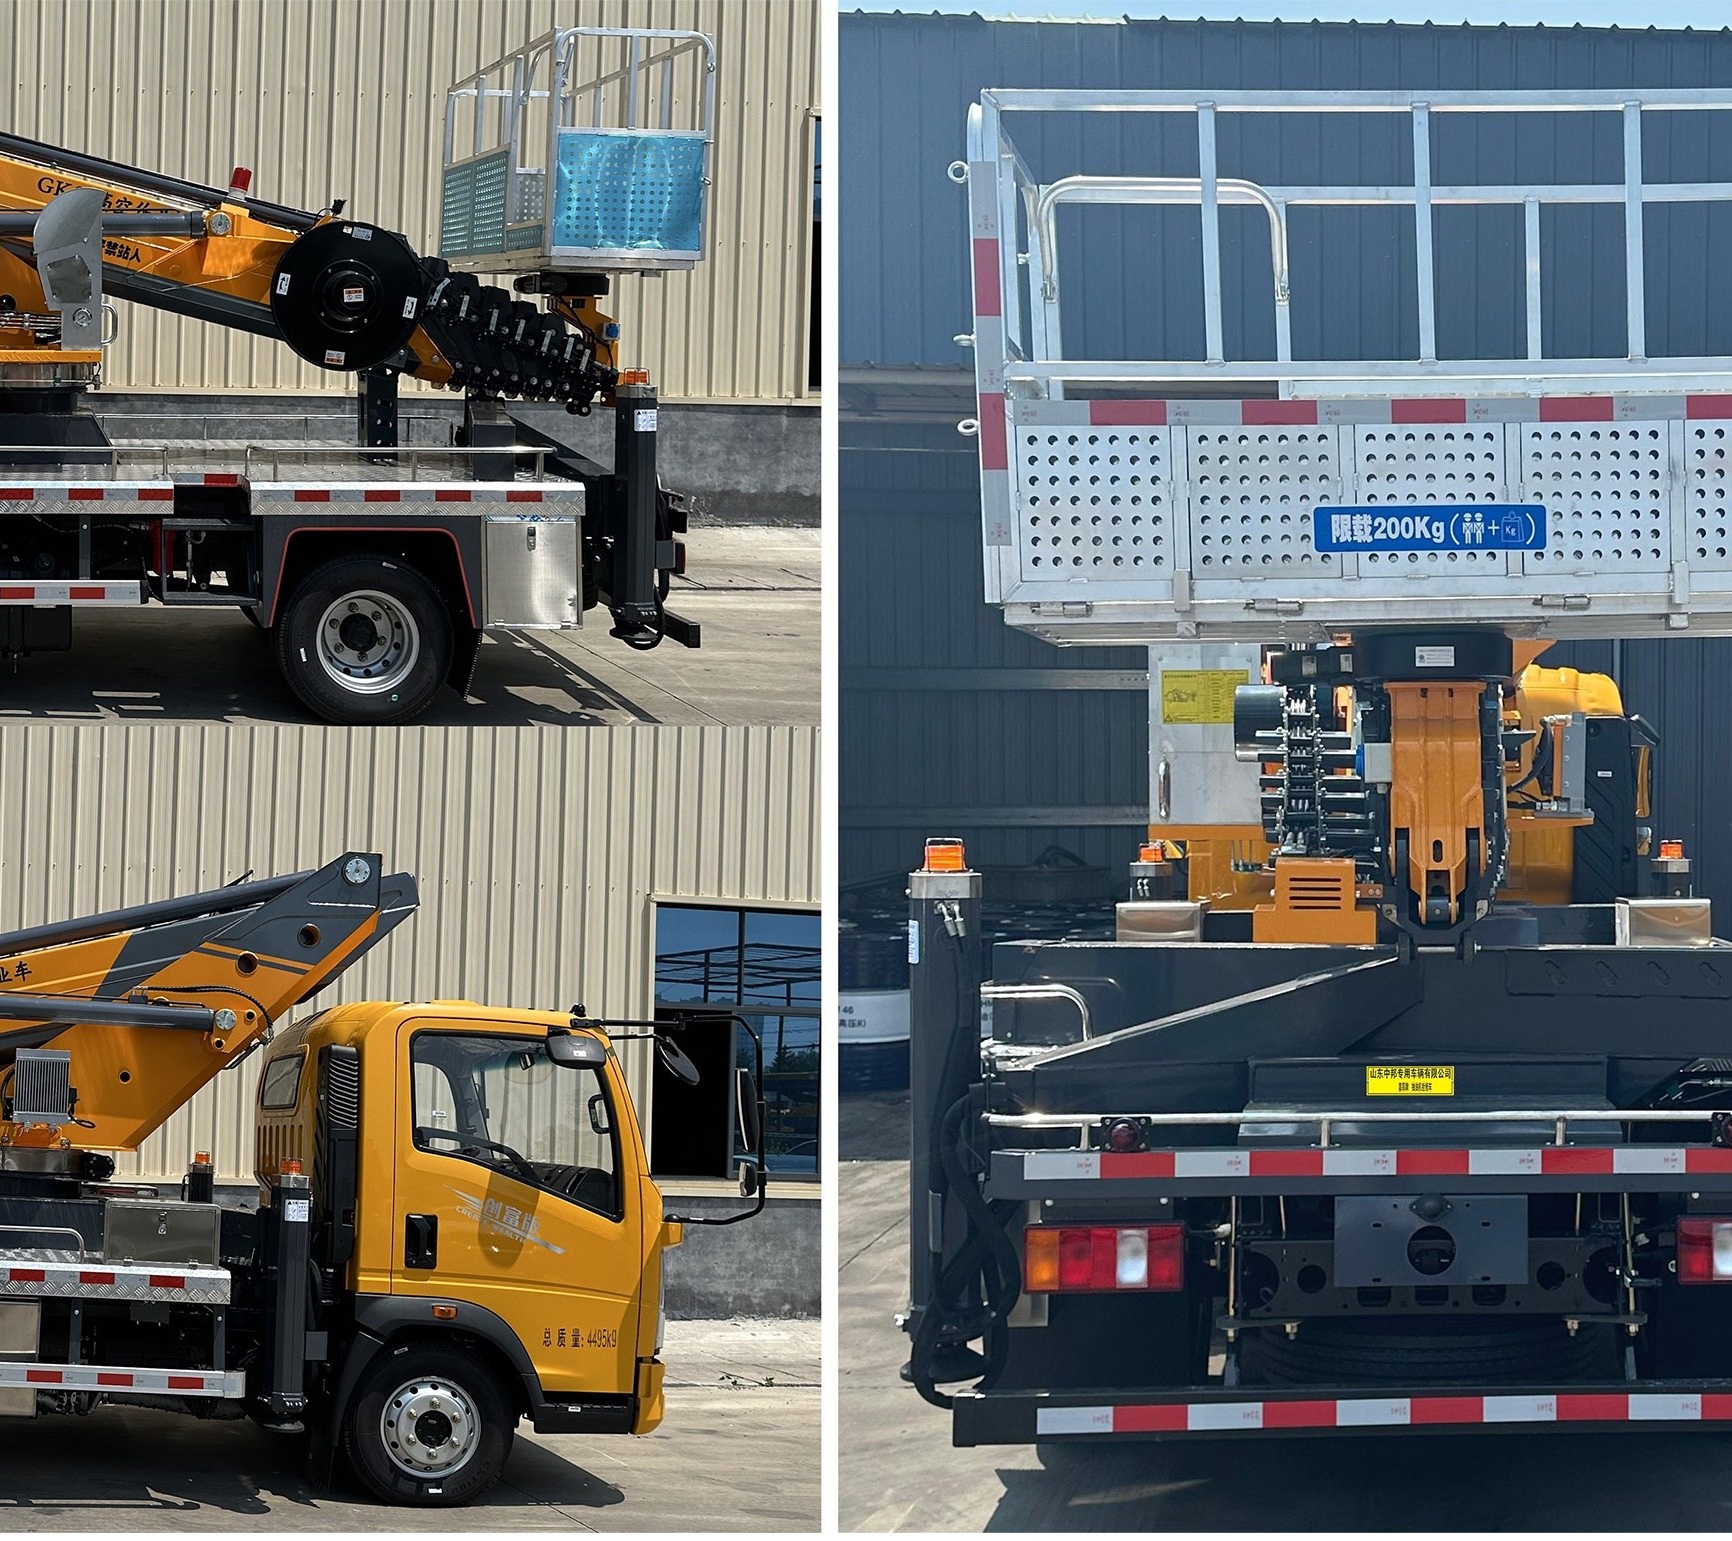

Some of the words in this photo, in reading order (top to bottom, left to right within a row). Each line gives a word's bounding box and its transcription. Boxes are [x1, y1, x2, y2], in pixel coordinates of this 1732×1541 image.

[37, 177, 81, 196] GK
[102, 238, 141, 262] 禁站人
[587, 1328, 617, 1348] 4495kg
